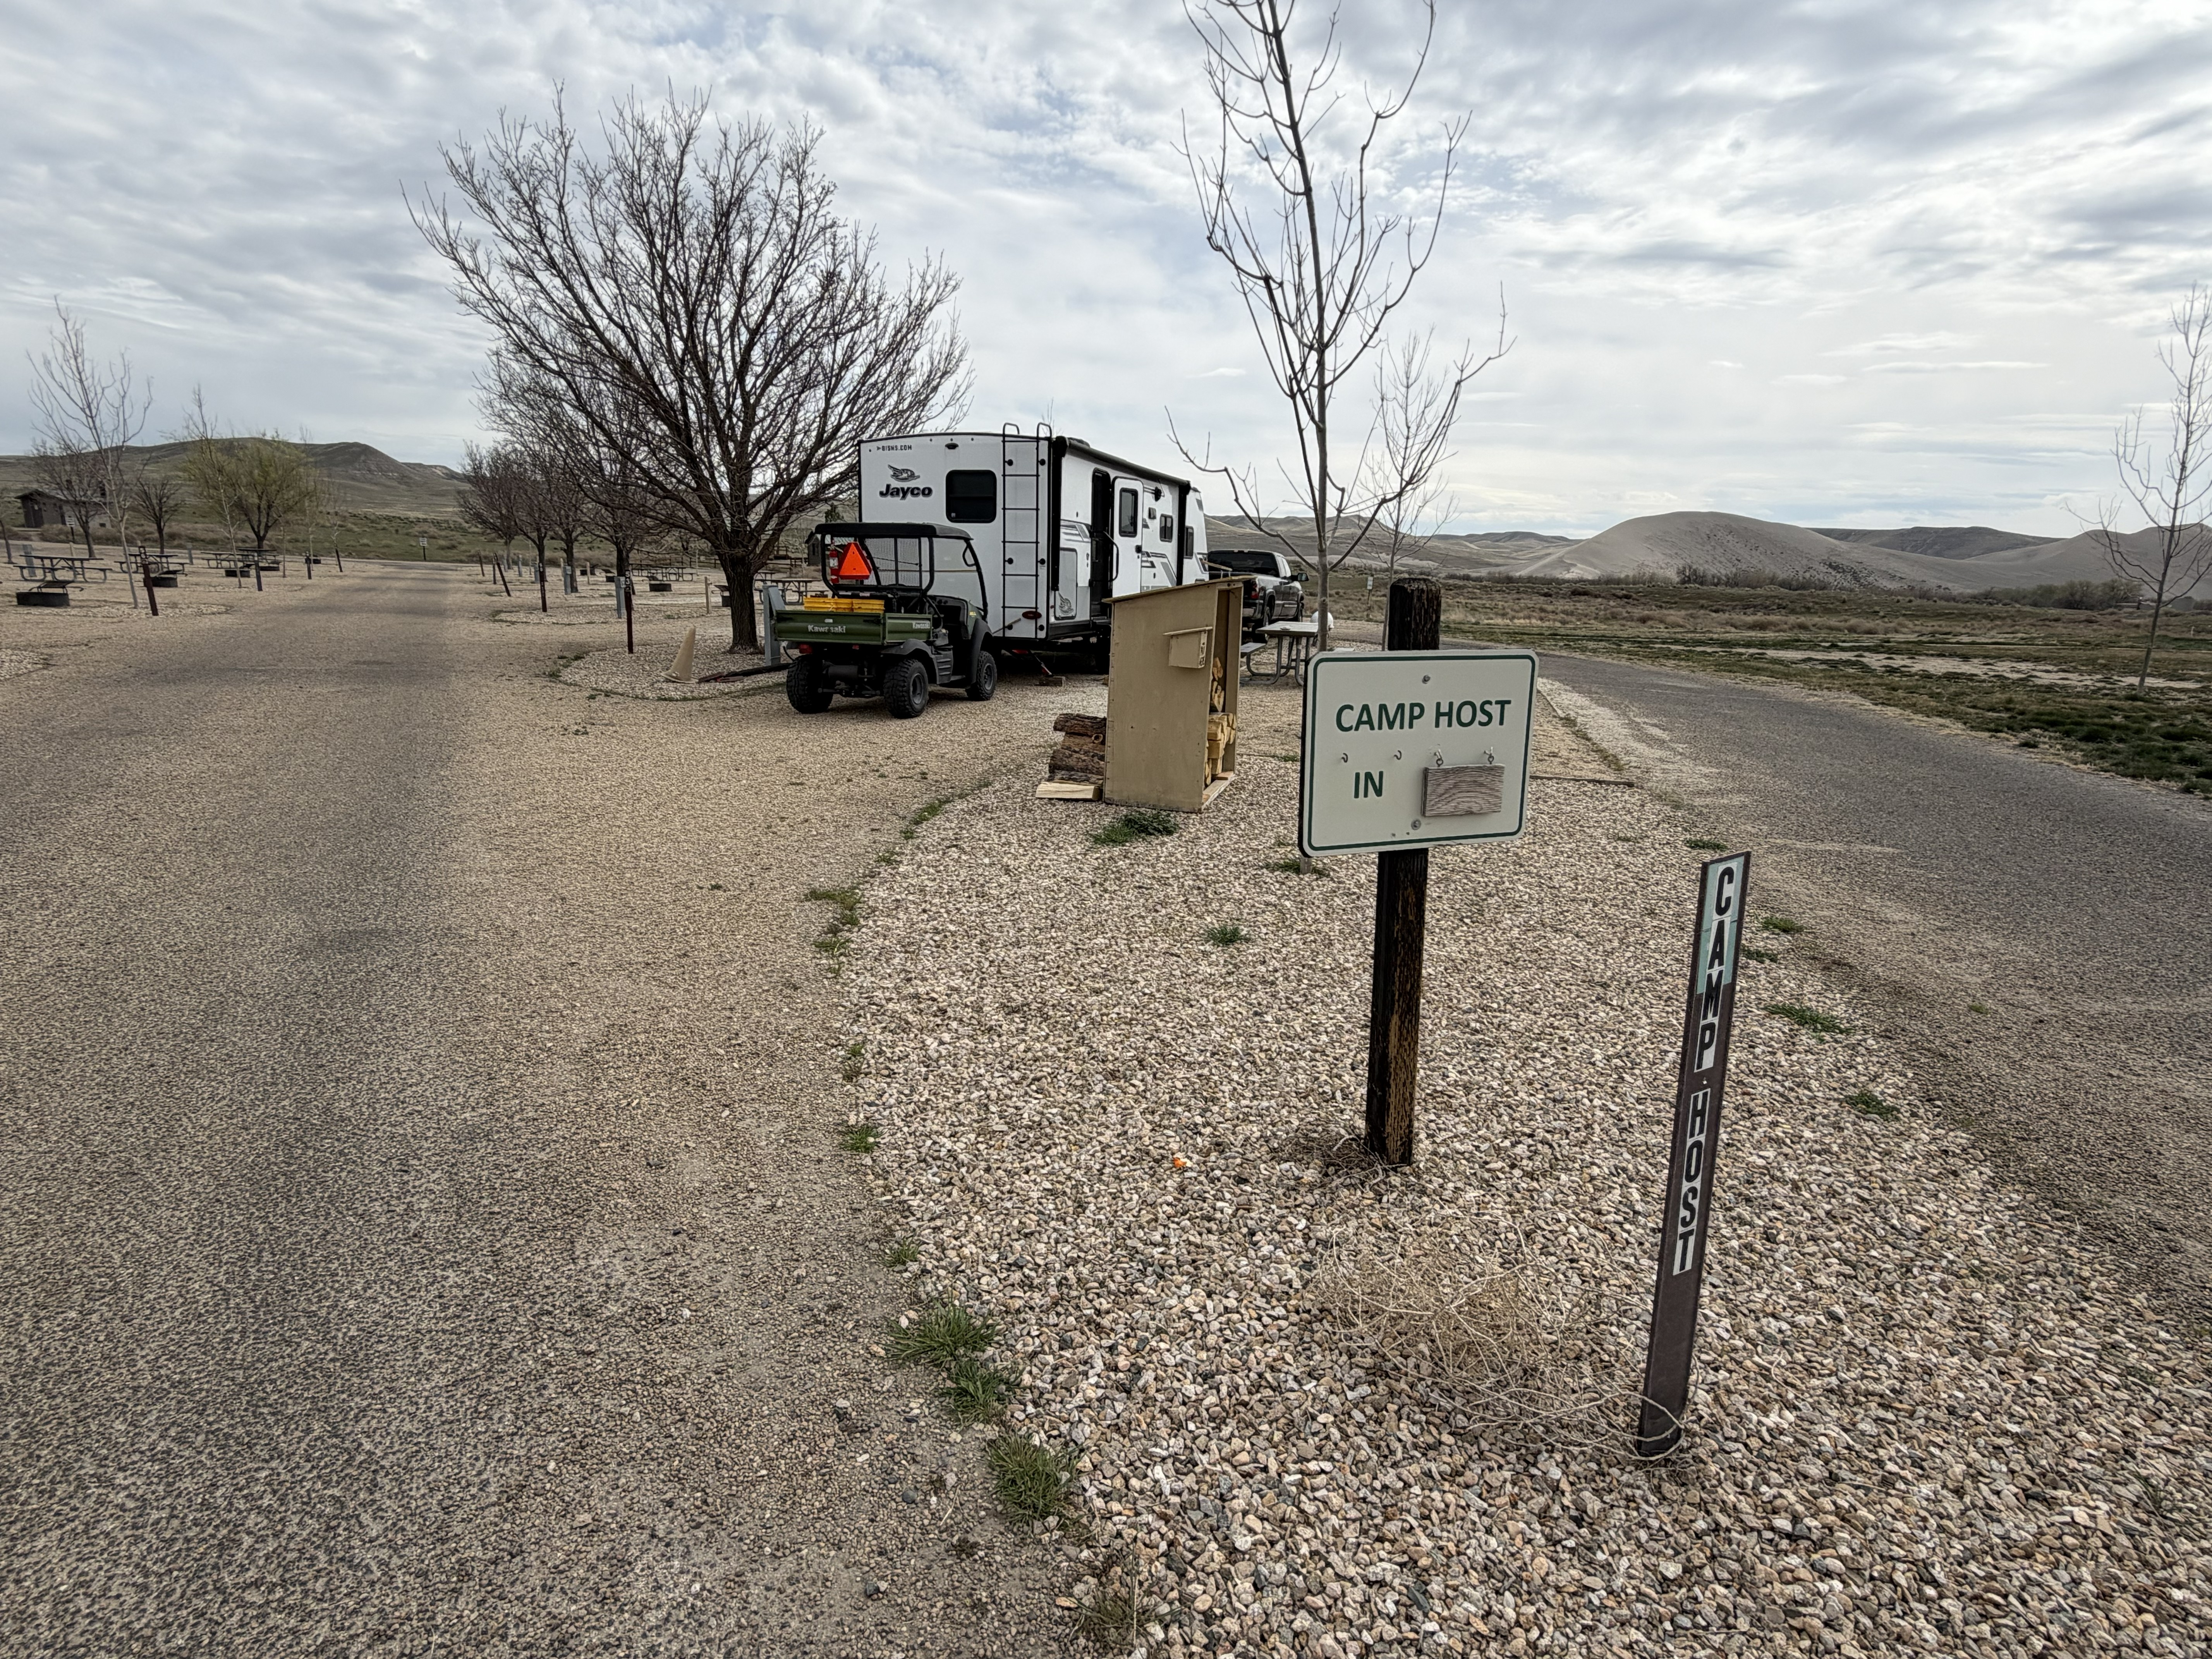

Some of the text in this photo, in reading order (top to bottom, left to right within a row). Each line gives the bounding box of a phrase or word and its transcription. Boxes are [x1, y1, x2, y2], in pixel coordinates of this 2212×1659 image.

[879, 484, 933, 500] Jayco
[1336, 700, 1512, 732] CAMP HOST
[1353, 771, 1384, 799] IN
[1679, 866, 1735, 1272] CAMP HOST
